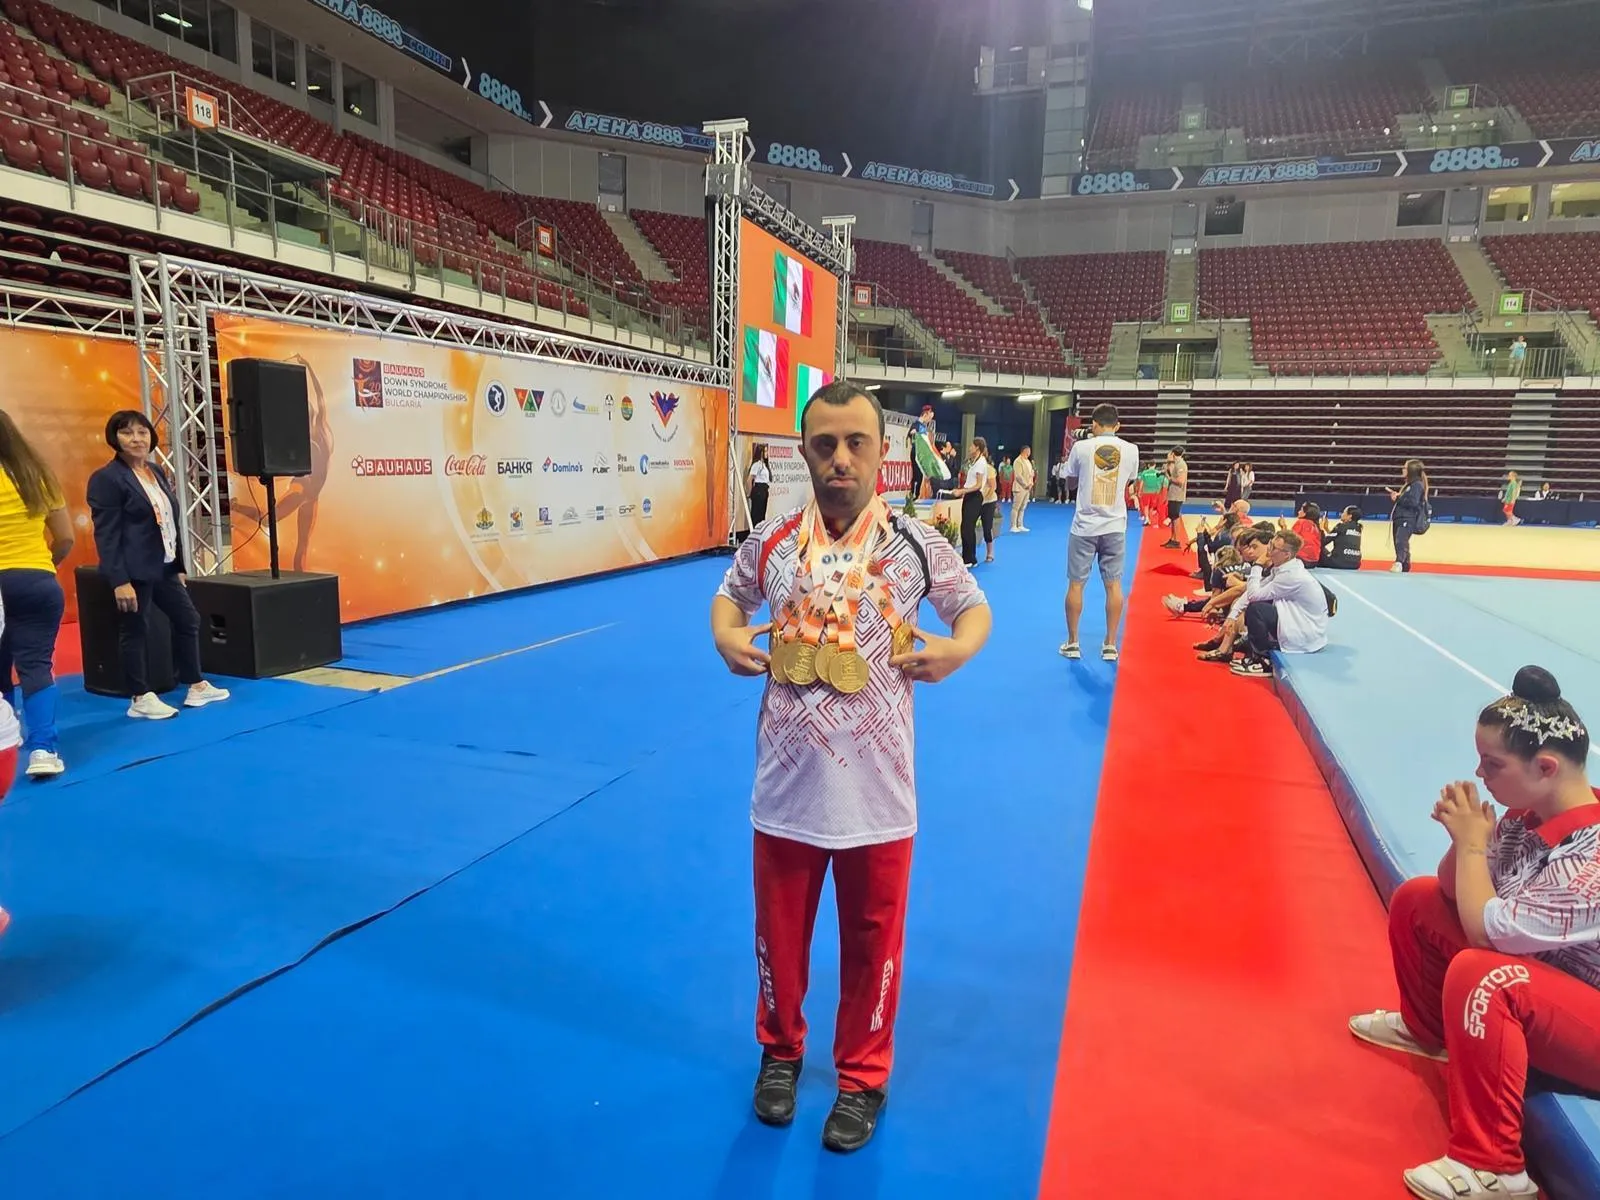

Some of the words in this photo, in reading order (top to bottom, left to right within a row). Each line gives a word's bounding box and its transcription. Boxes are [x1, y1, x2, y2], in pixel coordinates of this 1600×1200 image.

[361, 6, 403, 46] 8888
[195, 104, 212, 119] 118
[567, 112, 640, 139] АРЕНА
[641, 123, 684, 144] 8888
[864, 163, 919, 184] АРЕНА
[921, 171, 954, 190] 8888
[1201, 165, 1271, 184] АРЕНА
[1274, 163, 1319, 179] 8888
[384, 364, 425, 377] BAUHAUS
[384, 376, 408, 386] DOWN
[410, 379, 448, 391] SYNDROME
[384, 387, 412, 397] WORLD
[413, 389, 468, 402] CHAMPIONSHIPS
[385, 398, 422, 408] BULGARIA
[366, 459, 432, 476] BAUHAUS
[497, 461, 533, 475] БАНКЯ
[552, 462, 583, 473] Domino's
[882, 463, 914, 487] AUHAU
[1469, 963, 1530, 1040] SPORTOTO
